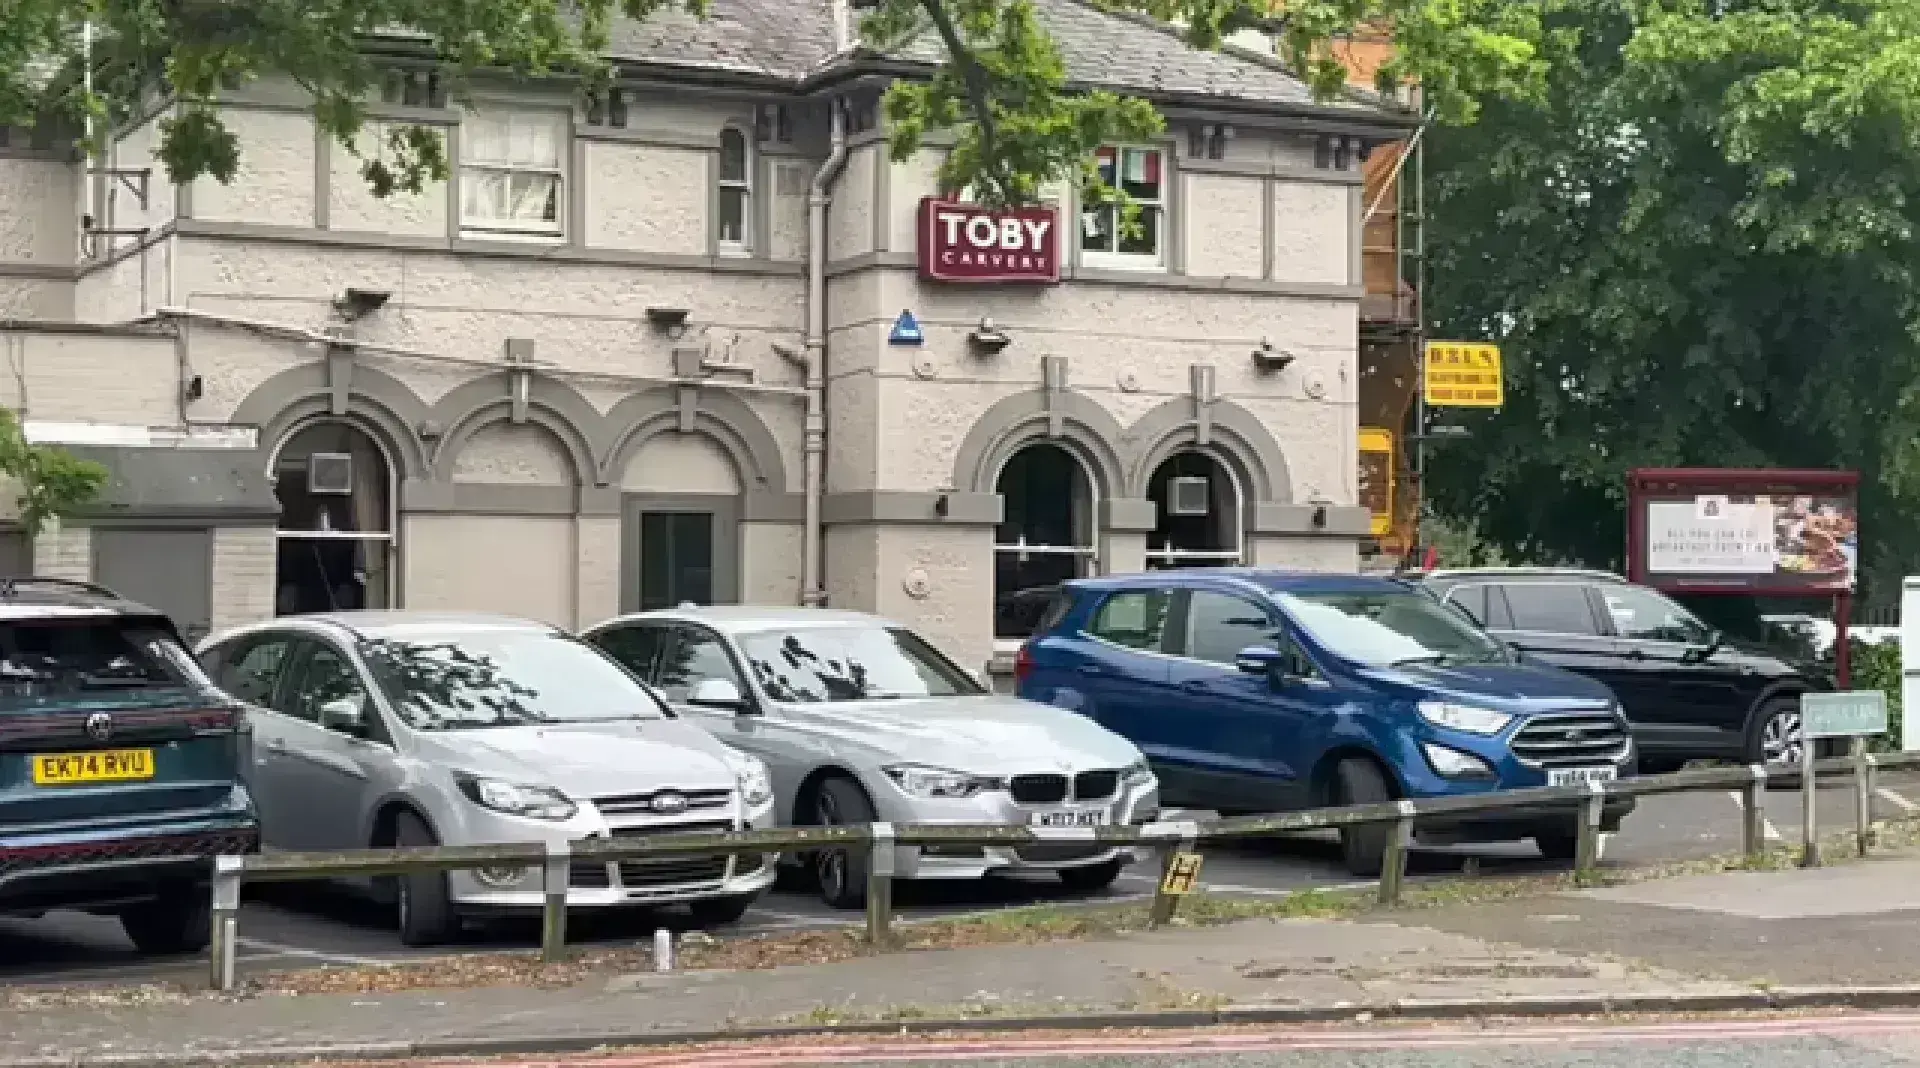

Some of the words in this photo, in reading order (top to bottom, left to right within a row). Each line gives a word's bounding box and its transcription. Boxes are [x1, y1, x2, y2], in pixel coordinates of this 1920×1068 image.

[937, 212, 1051, 252] TOBY
[942, 251, 1047, 270] CARVERY
[42, 757, 99, 777] EK74
[104, 751, 145, 774] RVU
[1166, 857, 1198, 892] H
